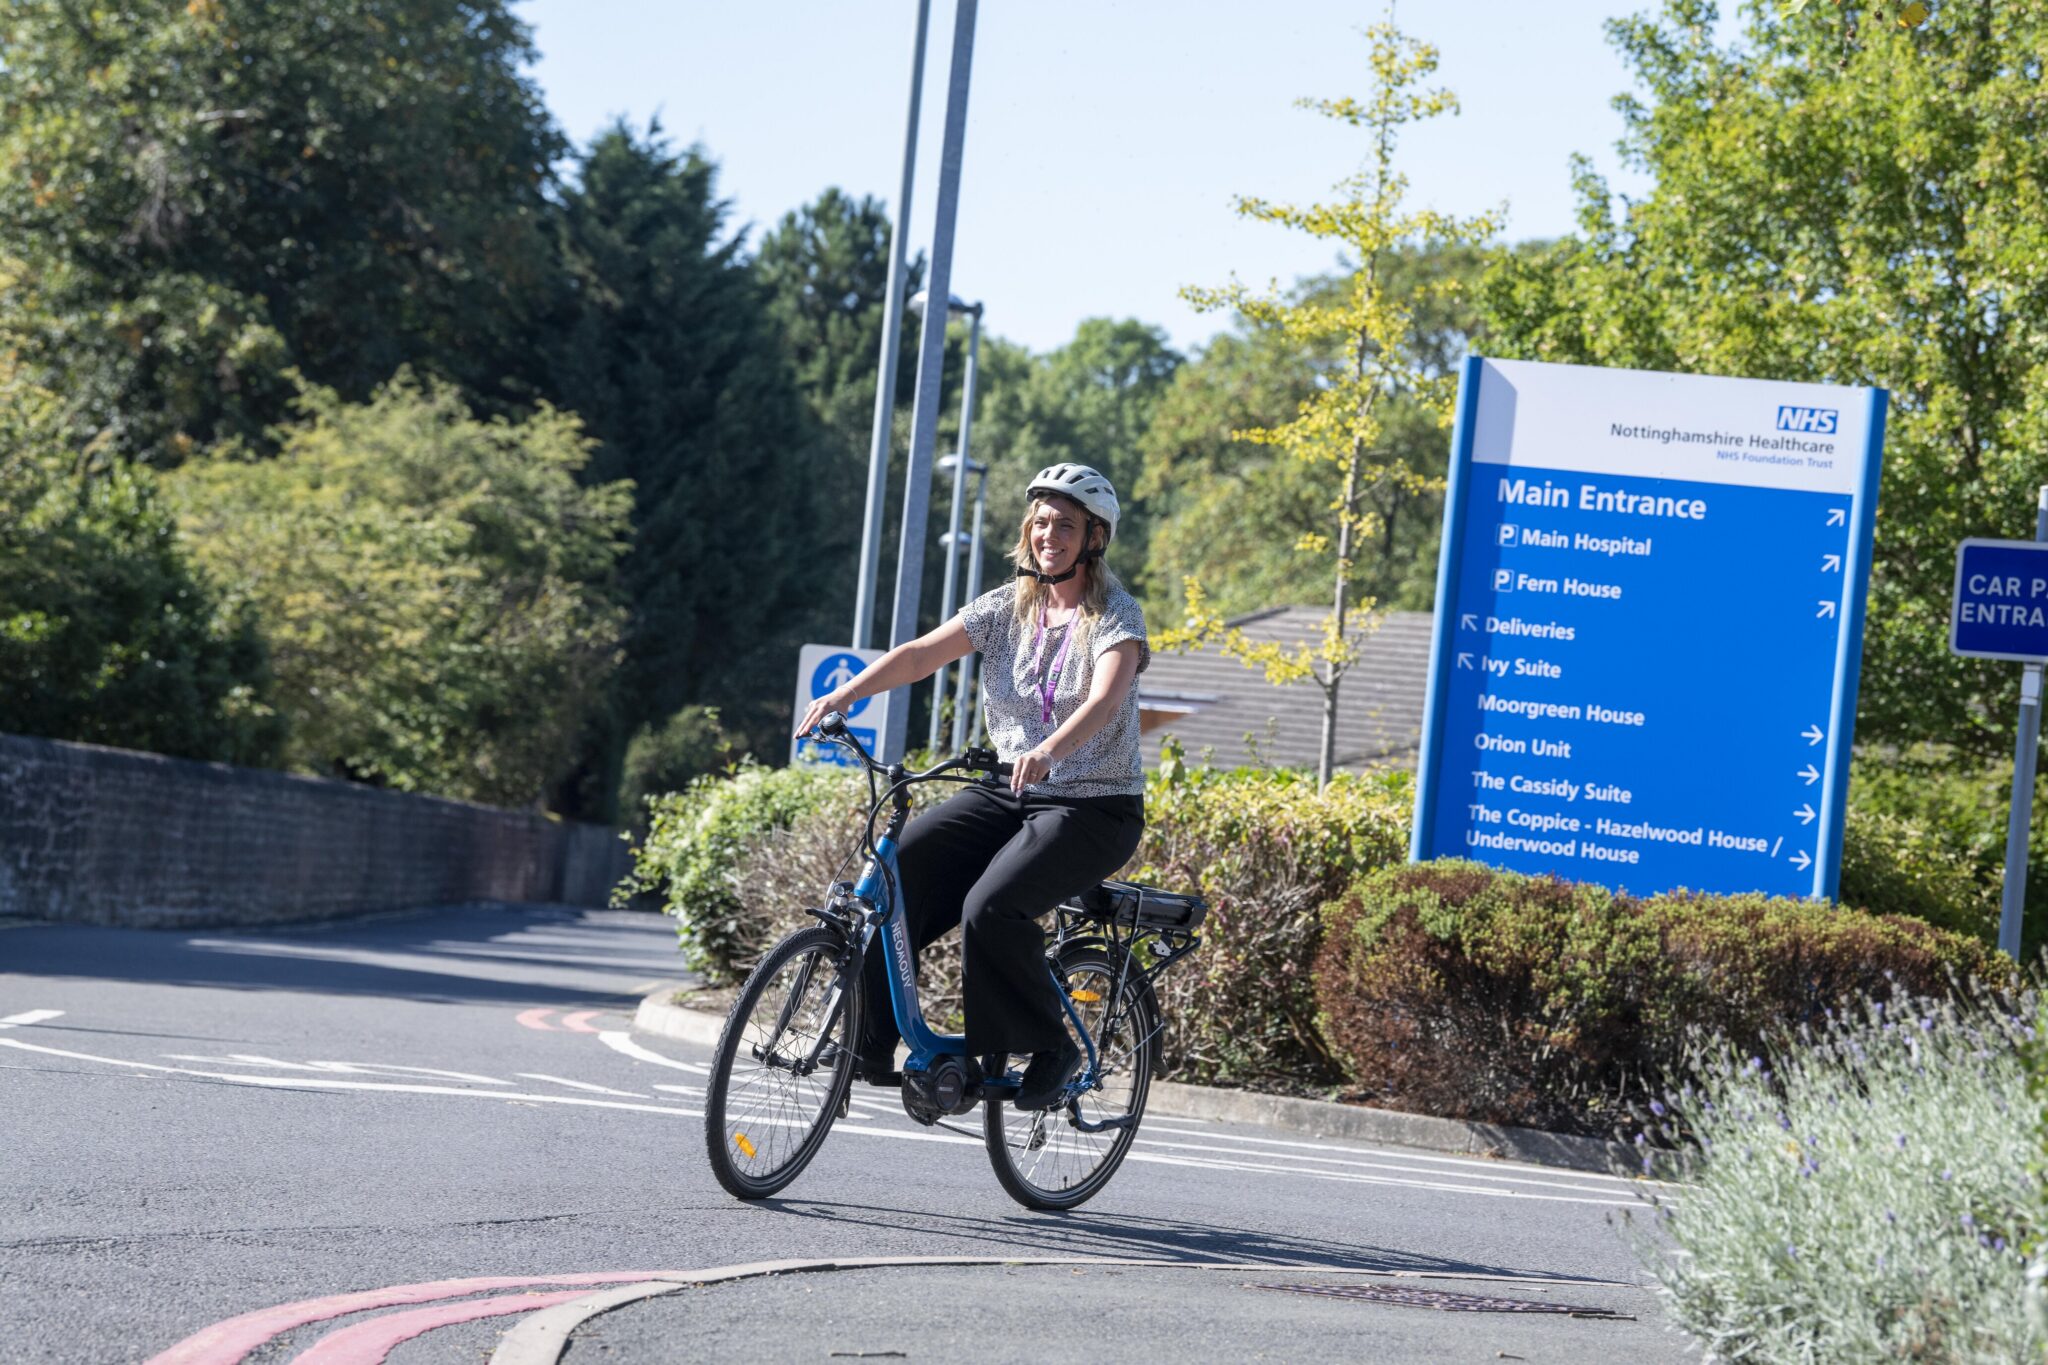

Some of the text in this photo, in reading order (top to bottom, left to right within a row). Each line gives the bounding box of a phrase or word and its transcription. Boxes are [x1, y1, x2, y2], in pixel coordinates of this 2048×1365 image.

[1777, 406, 1838, 433] NHS
[1610, 423, 1835, 454] Nottinghamshire Healthcare
[1716, 450, 1833, 469] NHS Foundation Trust
[1497, 478, 1707, 519] Main Entrance
[1499, 525, 1651, 557] P Main Hospital
[1494, 570, 1622, 600] P Fern House
[1968, 574, 2048, 600] CAR P
[1485, 616, 1575, 641] Deliveries
[1960, 602, 2048, 628] ENTRA
[1481, 655, 1562, 679] Ivy Suite
[1478, 694, 1645, 726] Moorgreen House
[1474, 733, 1572, 759] Orion Unit
[1472, 771, 1632, 803] The Cassidy Suite
[1469, 804, 1502, 824] The
[1507, 808, 1580, 837] Coppice
[1596, 817, 1703, 846] Hazelwood
[1708, 830, 1768, 852] House
[1466, 829, 1640, 864] Underwood House
[890, 921, 912, 989] NEOMOUV
